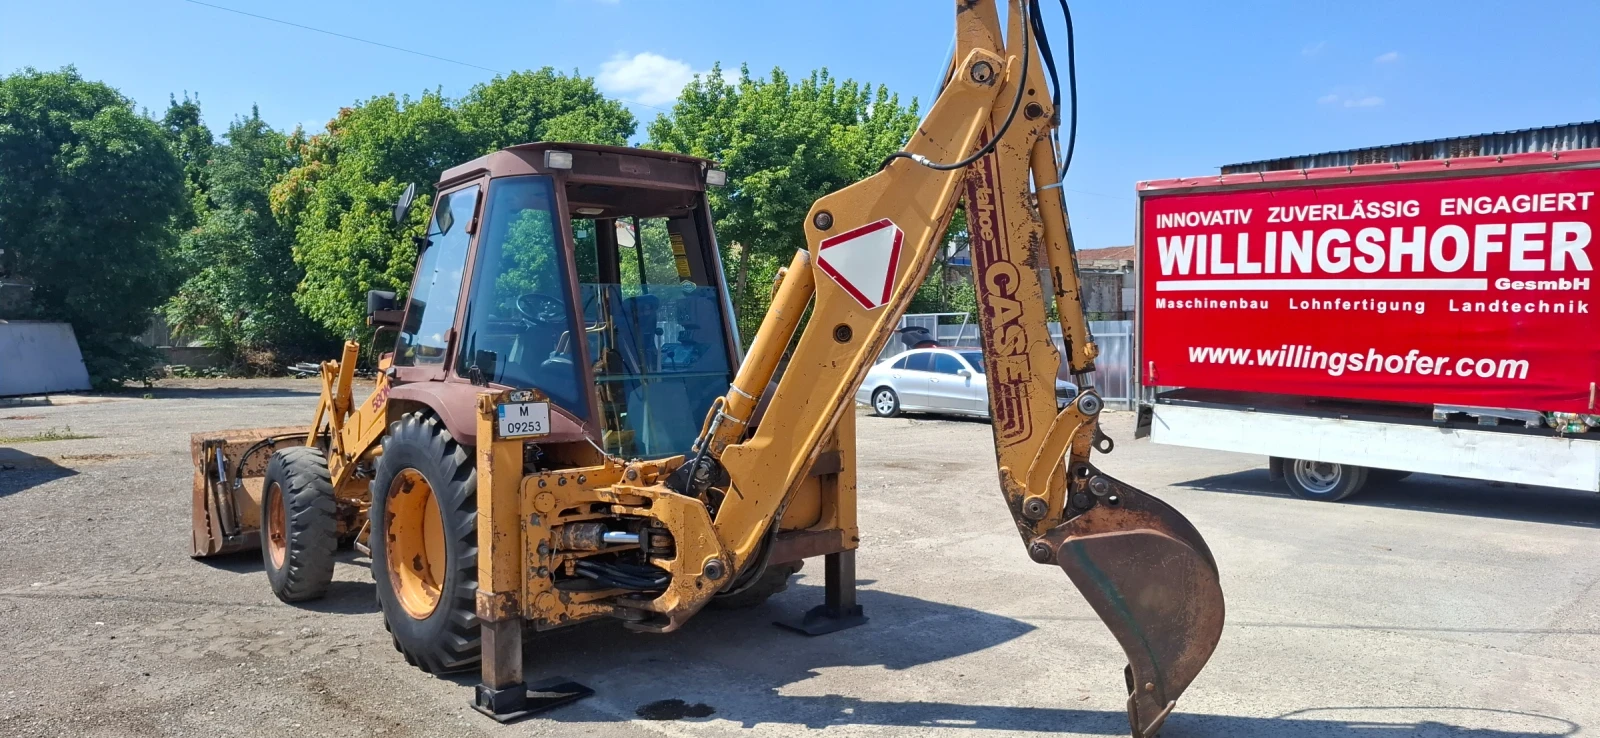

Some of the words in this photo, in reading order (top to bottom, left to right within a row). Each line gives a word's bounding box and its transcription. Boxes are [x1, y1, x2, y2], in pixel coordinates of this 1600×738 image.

[1156, 208, 1252, 229] INNOVATIV
[1267, 199, 1420, 222] ZUVERLÄSSIG
[1440, 191, 1595, 216] ENGAGIERT
[1156, 221, 1594, 276] WILLINGSHOFER
[1495, 277, 1590, 291] GesmbH
[1155, 297, 1269, 310] Maschinenbau
[1289, 297, 1425, 314] Lohnfertigung
[1449, 299, 1589, 314] Landtechnik
[984, 260, 1032, 384] CASE
[1188, 344, 1530, 380] www.willingshofer.com
[519, 405, 529, 417] M
[507, 420, 542, 434] 09253
